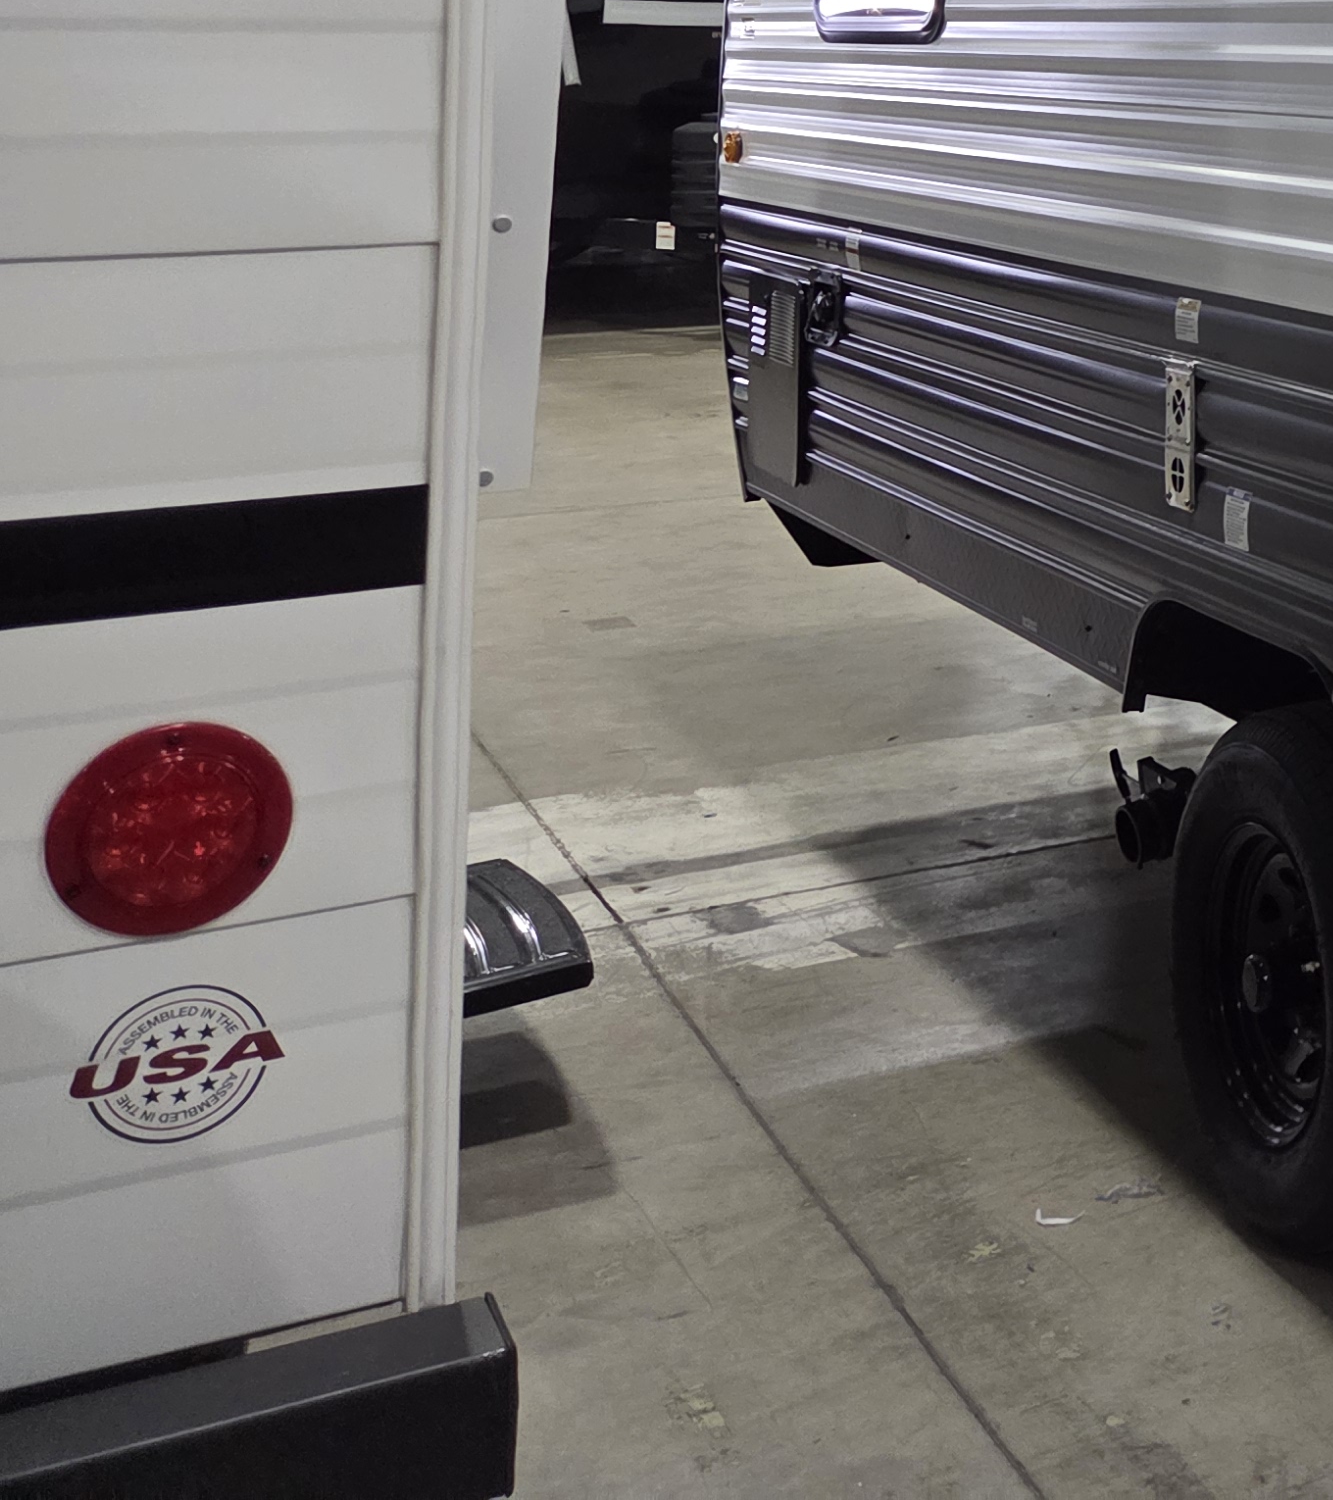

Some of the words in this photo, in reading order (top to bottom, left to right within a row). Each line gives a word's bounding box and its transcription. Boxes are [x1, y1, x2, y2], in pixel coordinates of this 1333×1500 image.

[118, 1005, 199, 1055] ASSEMBLED
[200, 1007, 217, 1020] IN
[216, 1012, 239, 1035] THE
[69, 1030, 285, 1099] USA
[116, 1093, 137, 1117] THE
[140, 1110, 156, 1123] IN
[158, 1071, 238, 1124] ASSEMBLED
